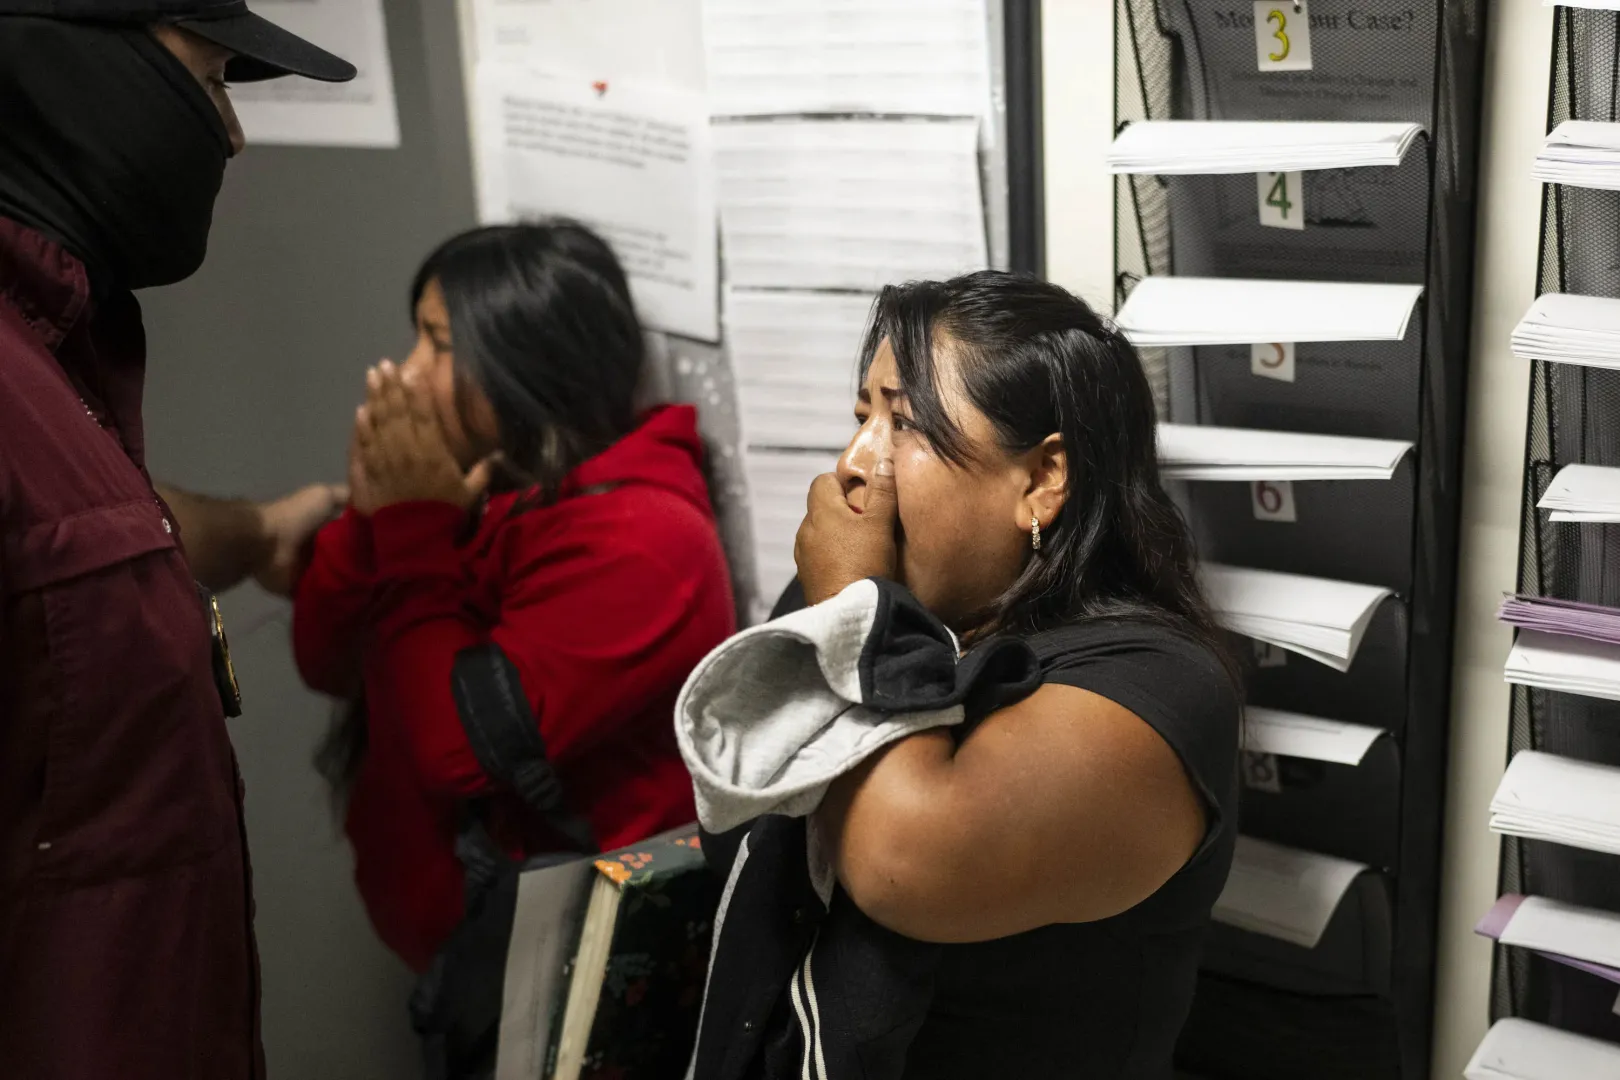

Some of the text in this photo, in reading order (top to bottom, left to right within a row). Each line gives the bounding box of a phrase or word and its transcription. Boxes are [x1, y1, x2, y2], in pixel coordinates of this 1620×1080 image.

[1266, 9, 1290, 61] 3
[1346, 8, 1414, 31] Case?
[1265, 171, 1292, 220] 4
[1256, 480, 1282, 514] 6
